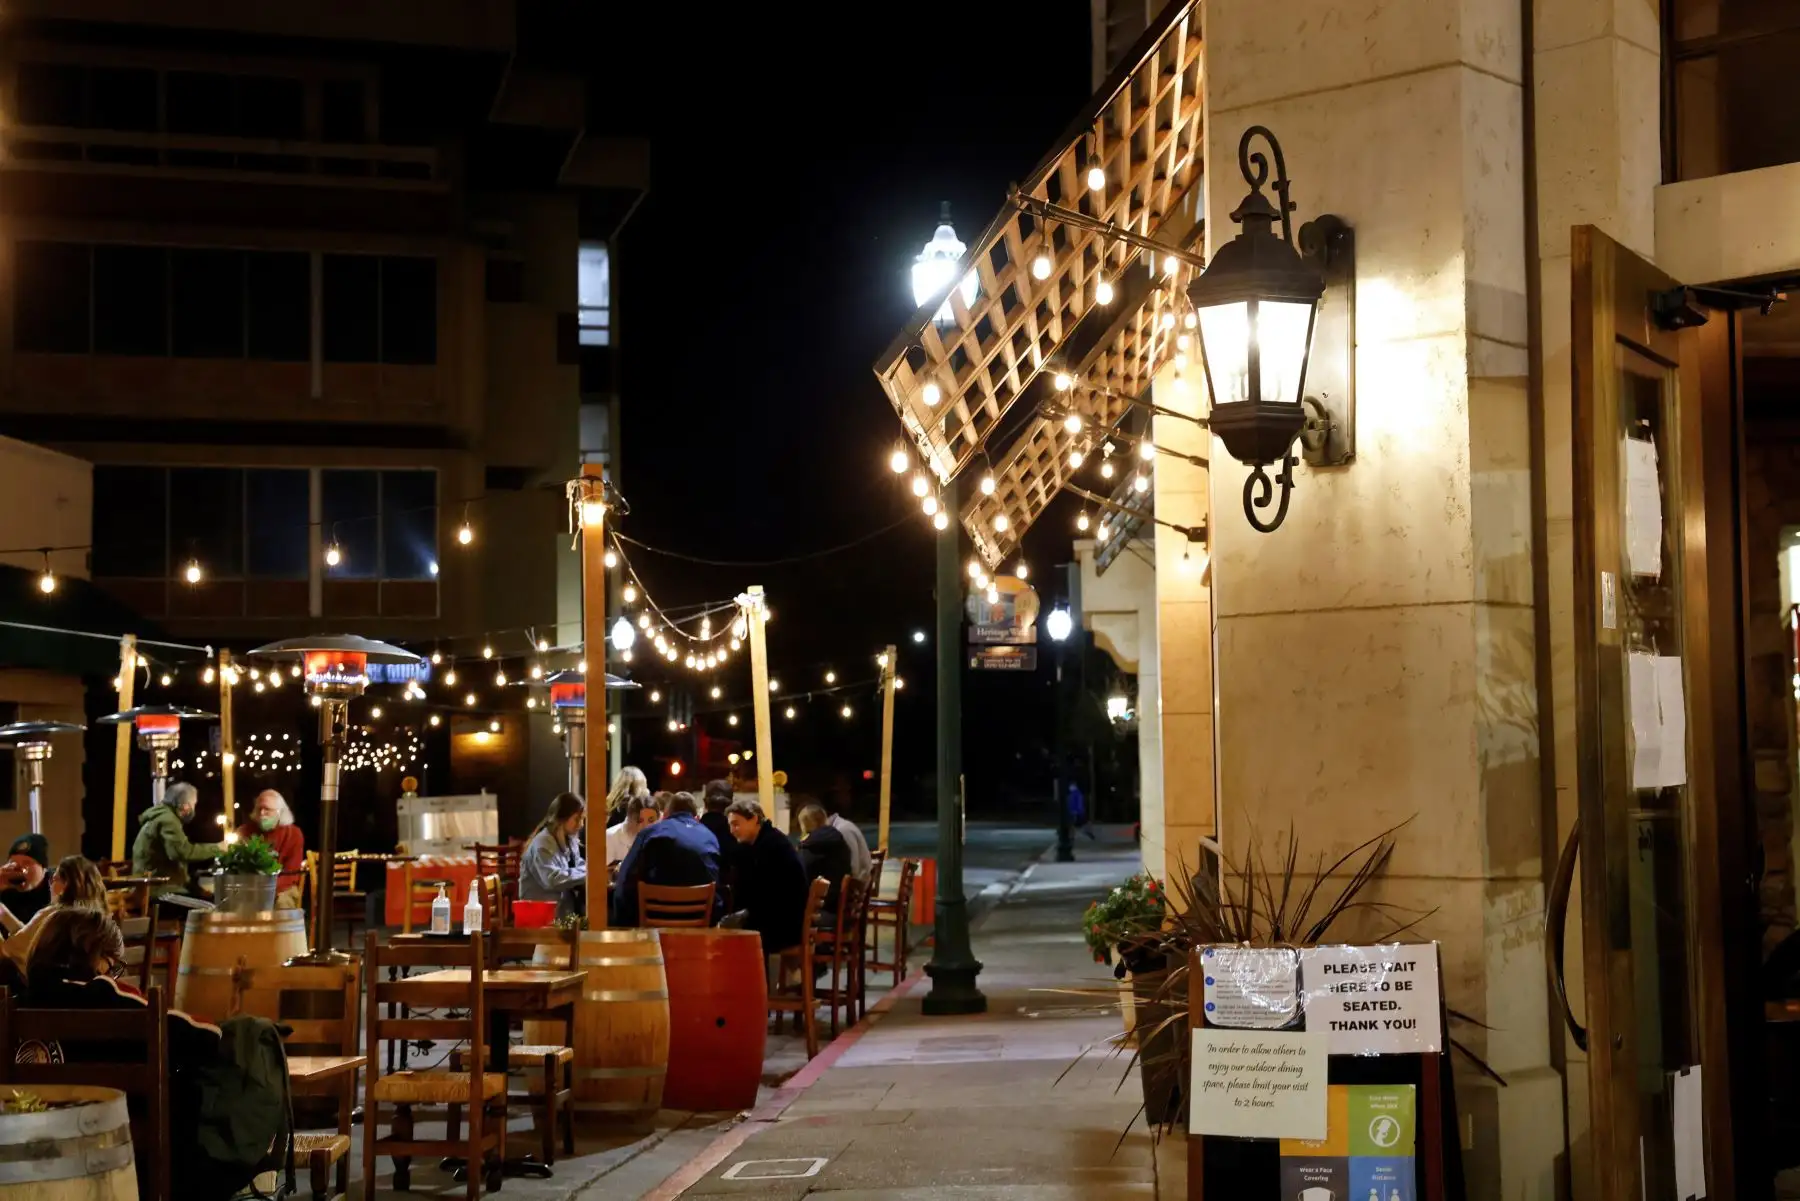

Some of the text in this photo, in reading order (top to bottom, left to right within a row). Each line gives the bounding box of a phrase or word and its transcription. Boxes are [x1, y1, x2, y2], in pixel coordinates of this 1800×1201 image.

[1323, 961, 1416, 975] PLEASE WAIT
[1329, 980, 1413, 993] HERE TO BE
[1343, 1000, 1402, 1012] SEATED.
[1329, 1018, 1416, 1031] THANK YOU!
[1207, 1042, 1306, 1056] In order to allow others to
[1208, 1061, 1303, 1078] enjoy our outdoor dining
[1202, 1077, 1309, 1095] space, please limit your visit
[1234, 1096, 1275, 1107] to 2 hours.
